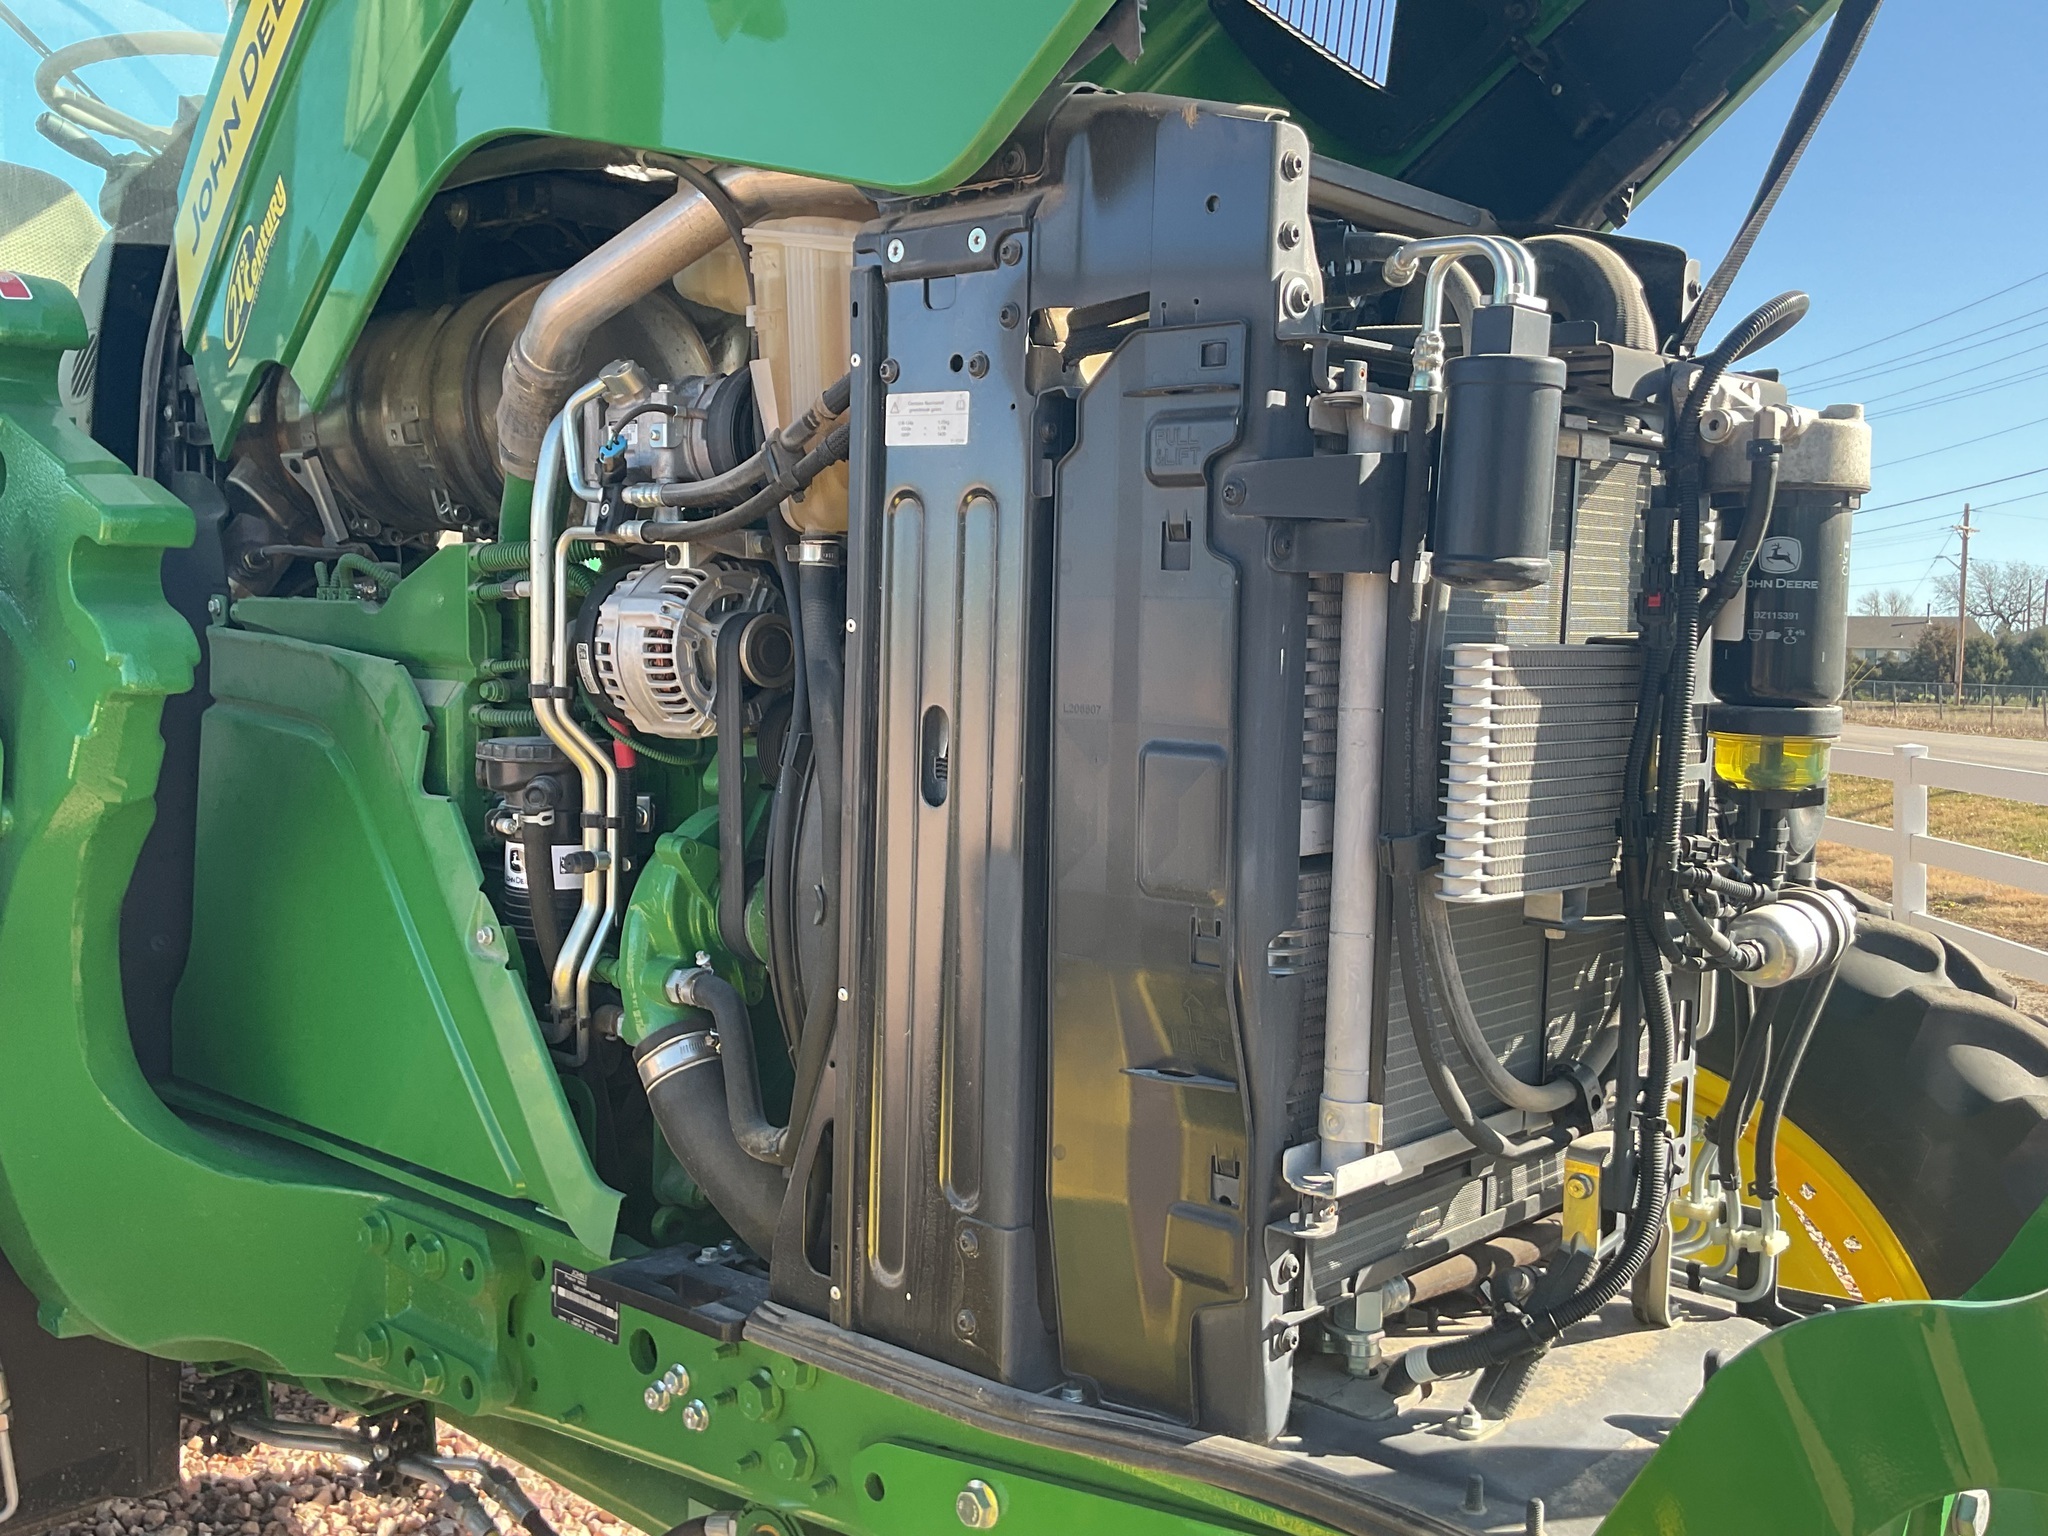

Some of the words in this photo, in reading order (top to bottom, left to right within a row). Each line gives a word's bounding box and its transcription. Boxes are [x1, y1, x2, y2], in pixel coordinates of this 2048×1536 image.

[191, 96, 242, 257] JOHN
[1155, 426, 1198, 446] PULL
[1745, 580, 1773, 589] OHN
[1775, 578, 1819, 589] DEERE
[1753, 611, 1799, 620] DZ115391
